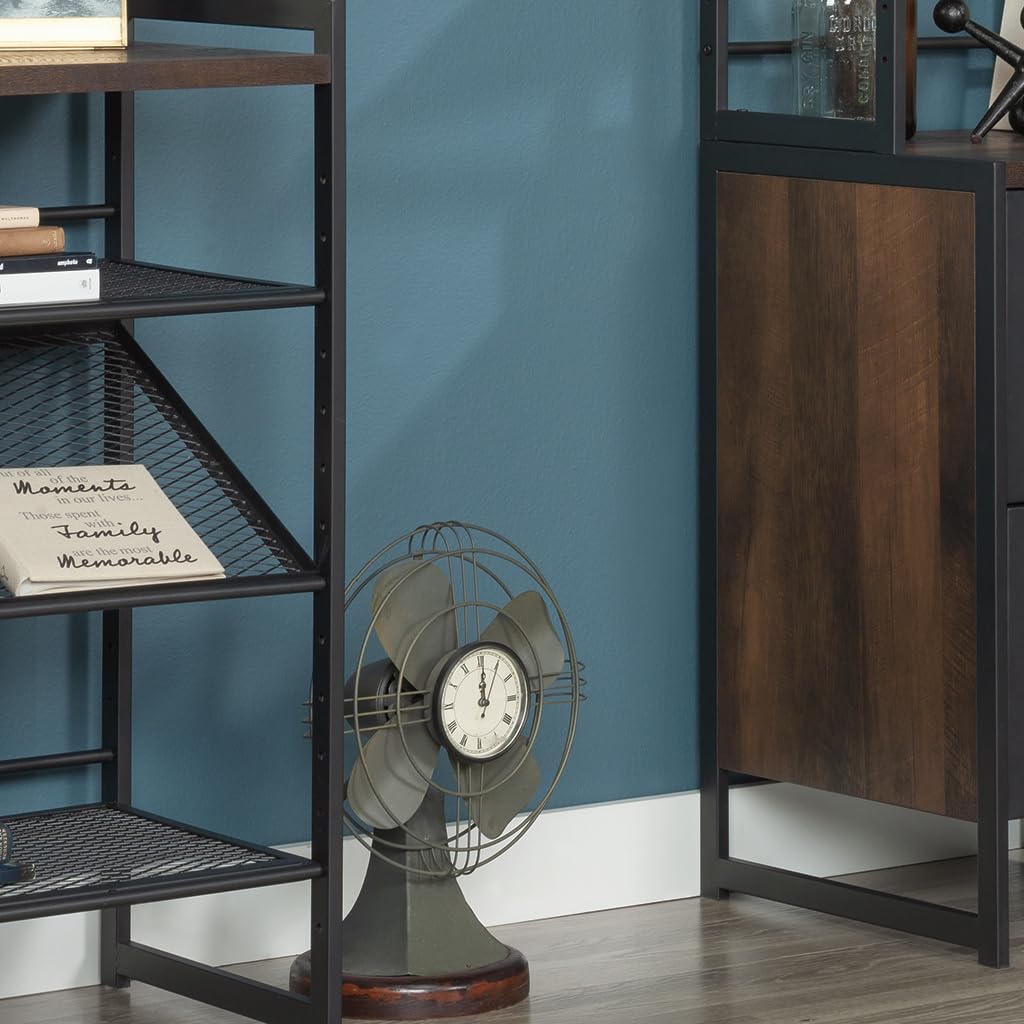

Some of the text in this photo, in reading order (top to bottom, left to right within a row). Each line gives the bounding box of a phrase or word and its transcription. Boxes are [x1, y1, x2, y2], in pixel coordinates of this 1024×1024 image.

[34, 468, 52, 477] all
[49, 474, 88, 485] of the
[13, 478, 136, 495] Moments
[56, 496, 71, 505] in
[73, 495, 95, 504] our
[18, 509, 101, 521] Those spent
[84, 518, 115, 528] with
[50, 521, 162, 544] Family
[72, 545, 154, 558] are the most
[56, 548, 198, 569] Memorable
